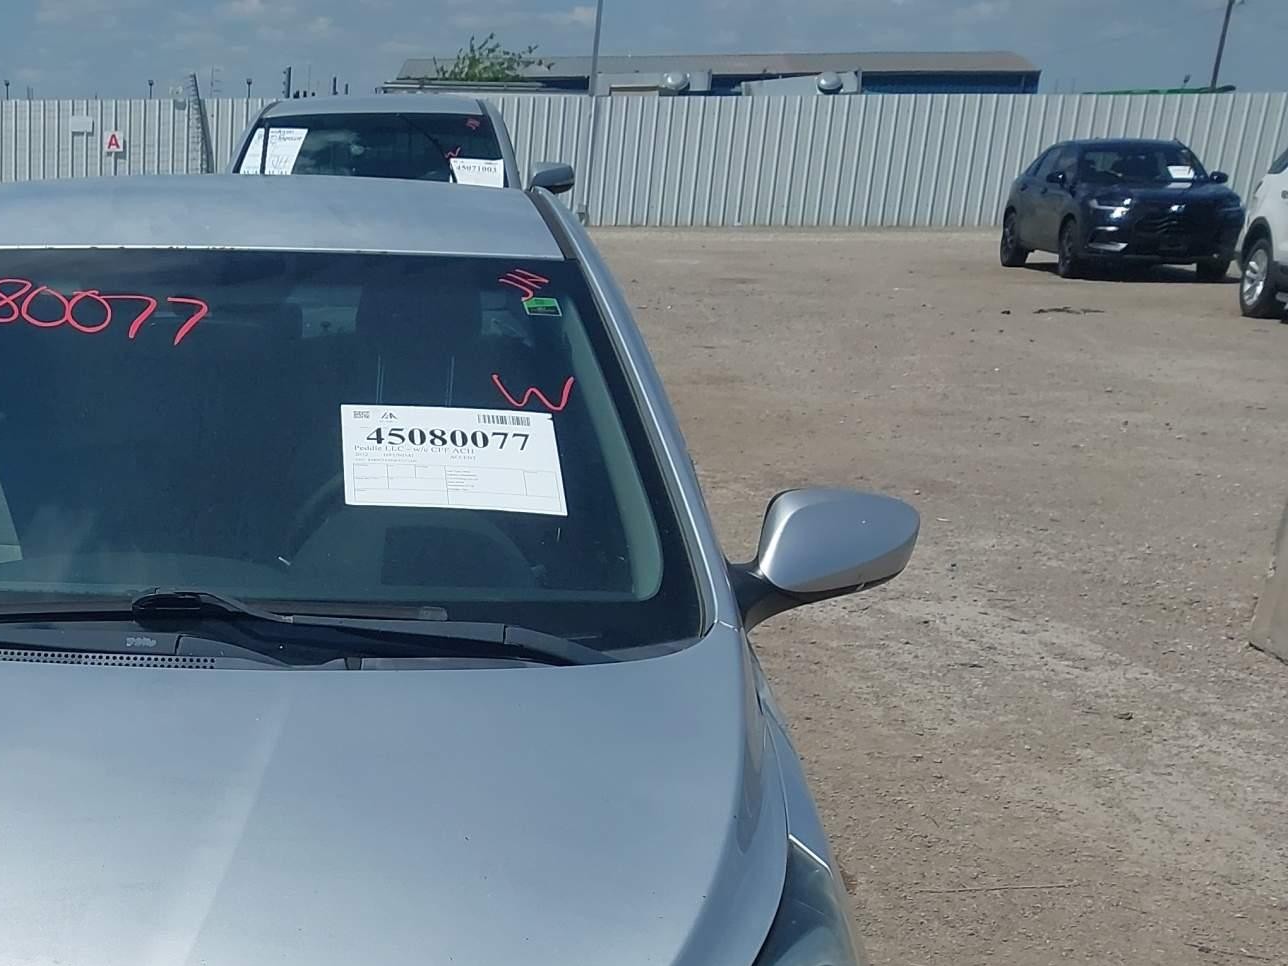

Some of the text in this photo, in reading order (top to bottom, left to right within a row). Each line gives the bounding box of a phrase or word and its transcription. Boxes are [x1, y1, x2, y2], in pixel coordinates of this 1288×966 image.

[107, 134, 120, 149] A
[492, 374, 575, 411] W
[366, 426, 530, 452] 45080077
